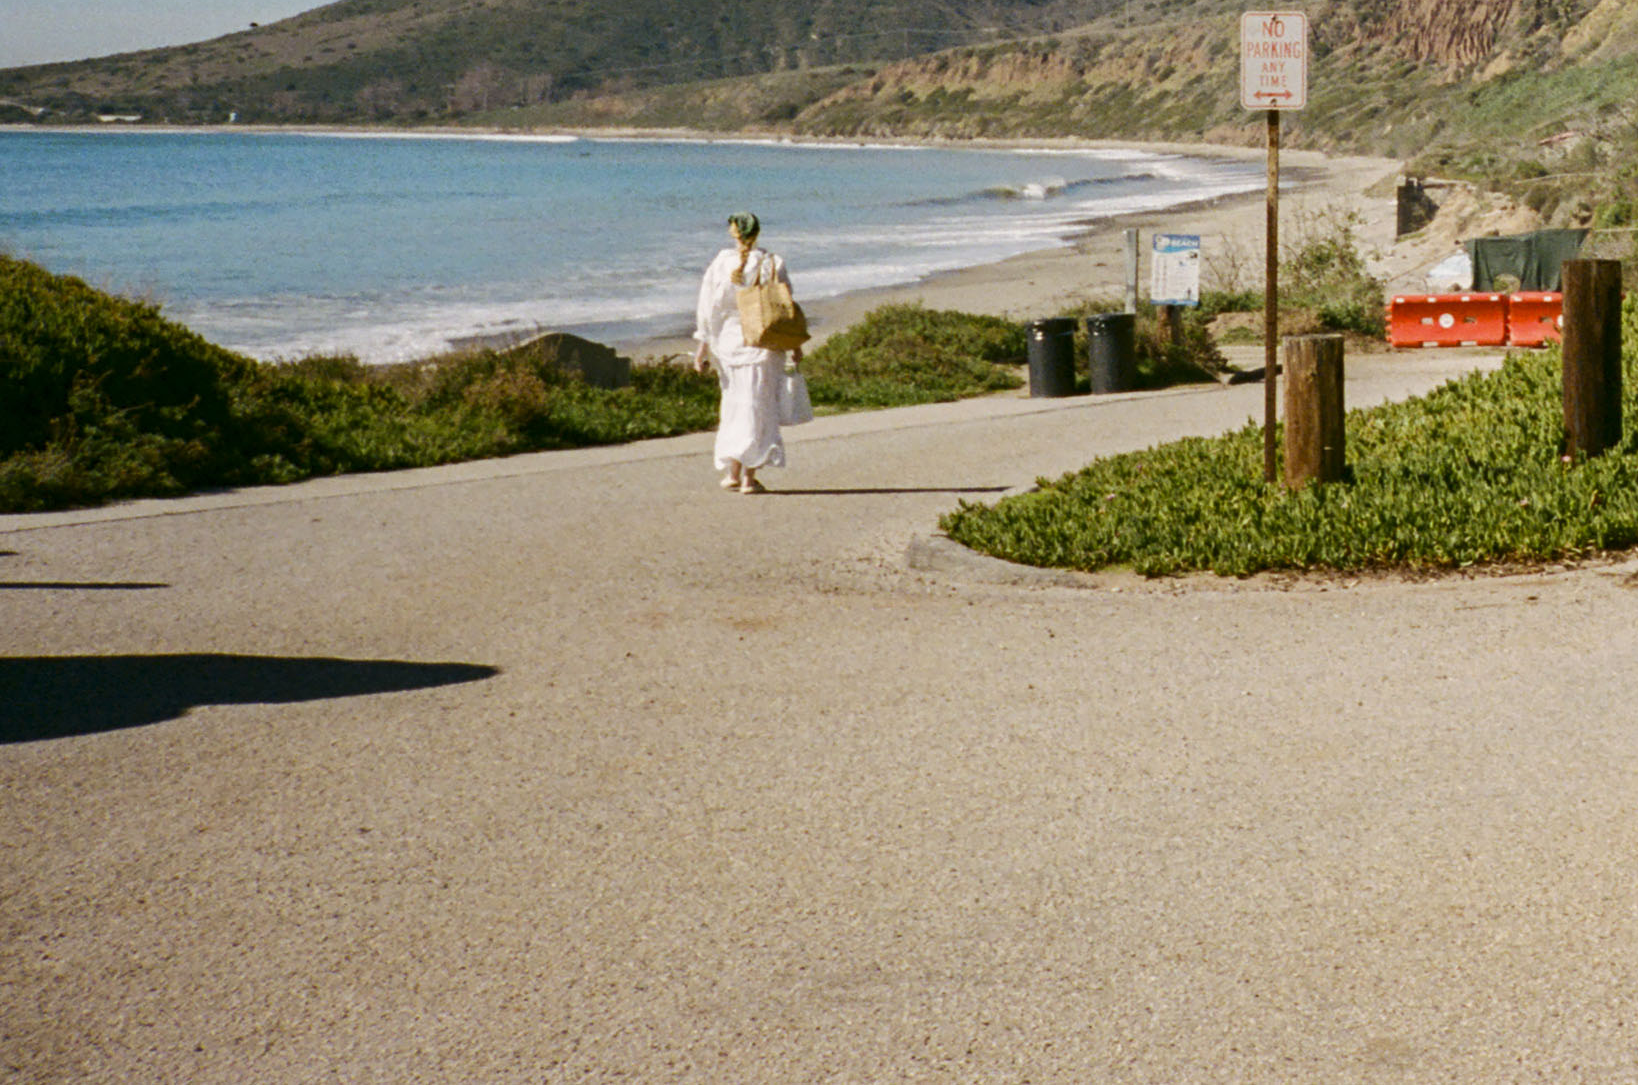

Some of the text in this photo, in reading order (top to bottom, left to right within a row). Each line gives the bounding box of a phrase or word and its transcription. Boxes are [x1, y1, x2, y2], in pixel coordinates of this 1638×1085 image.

[1262, 20, 1285, 37] NO
[1247, 41, 1301, 59] PARKING
[1261, 61, 1286, 73] ANY
[1259, 75, 1288, 87] TIME
